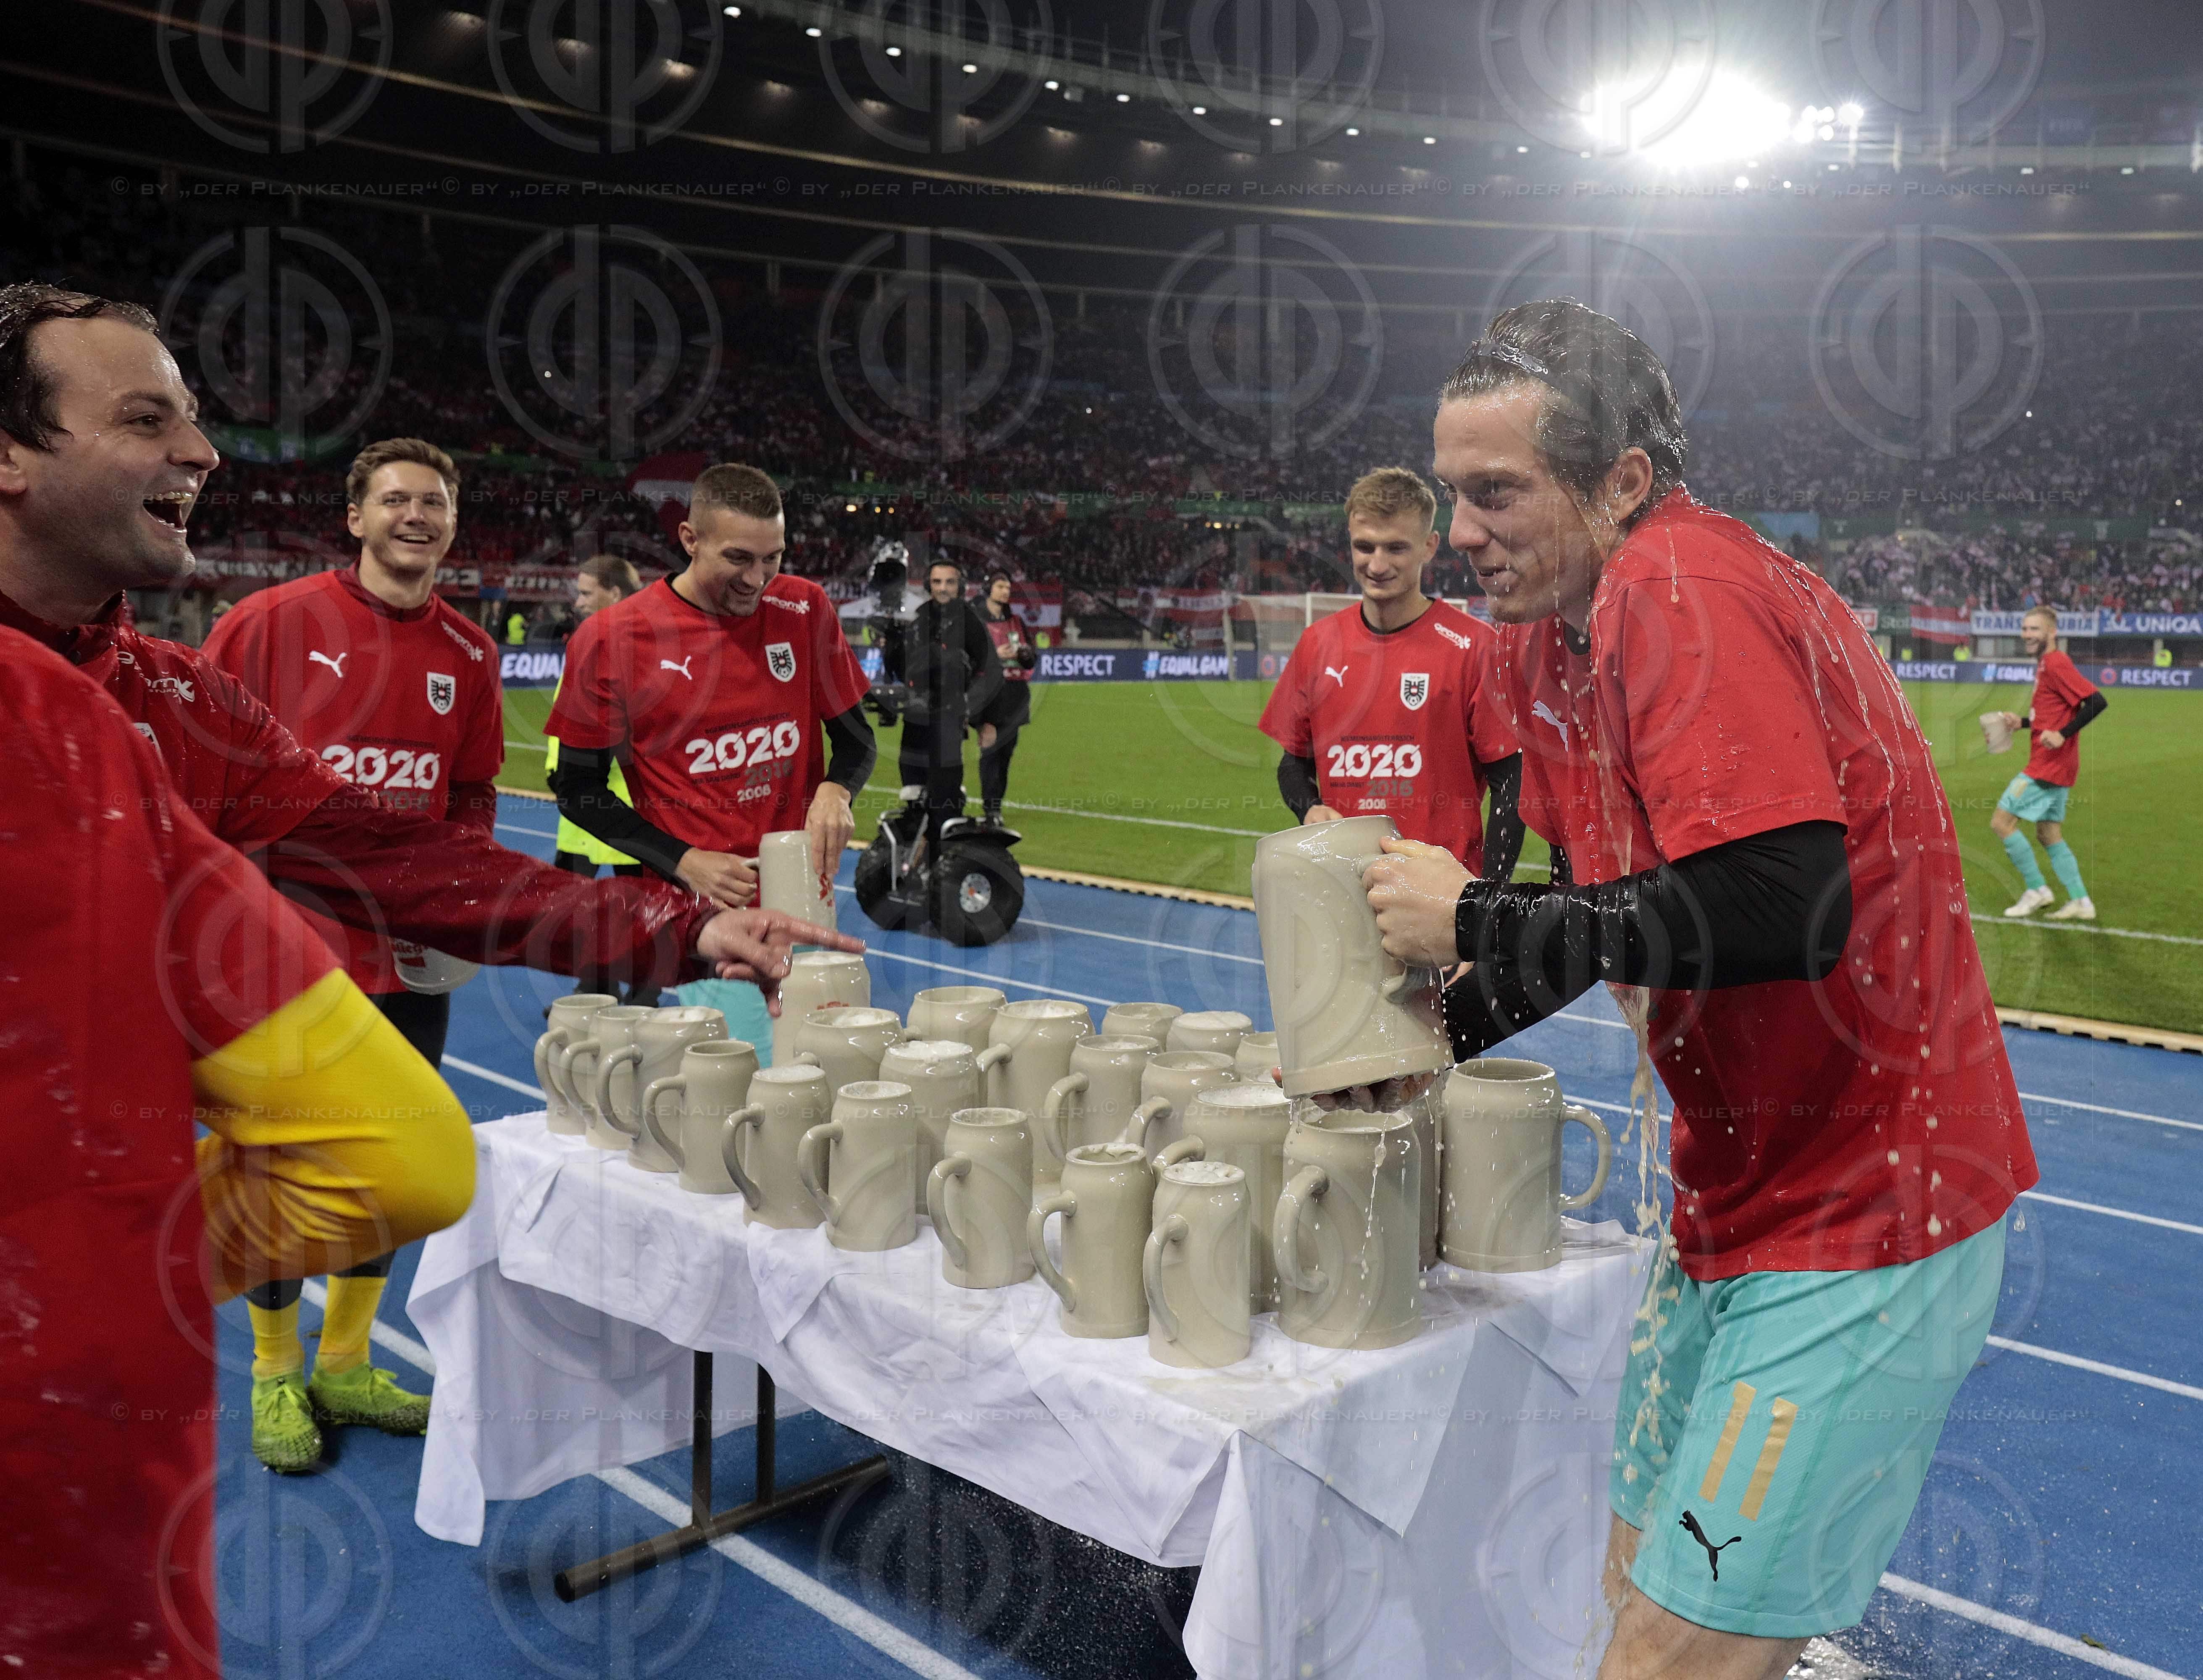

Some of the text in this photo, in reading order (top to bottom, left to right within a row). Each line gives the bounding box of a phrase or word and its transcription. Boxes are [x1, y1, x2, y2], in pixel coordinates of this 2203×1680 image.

[2136, 615, 2202, 633] UNIQA
[1041, 654, 1116, 676] RESPECT
[1896, 662, 1956, 679] RESPECT
[2122, 669, 2192, 686] RESPECT
[685, 720, 800, 774] 2020
[321, 744, 441, 790] 2020
[1327, 744, 1422, 779] 2020
[744, 759, 794, 786] 2016
[737, 784, 771, 803] 2008
[1366, 780, 1413, 797] 2016
[1357, 799, 1386, 810] 2008
[1698, 1381, 1798, 1521] 11
